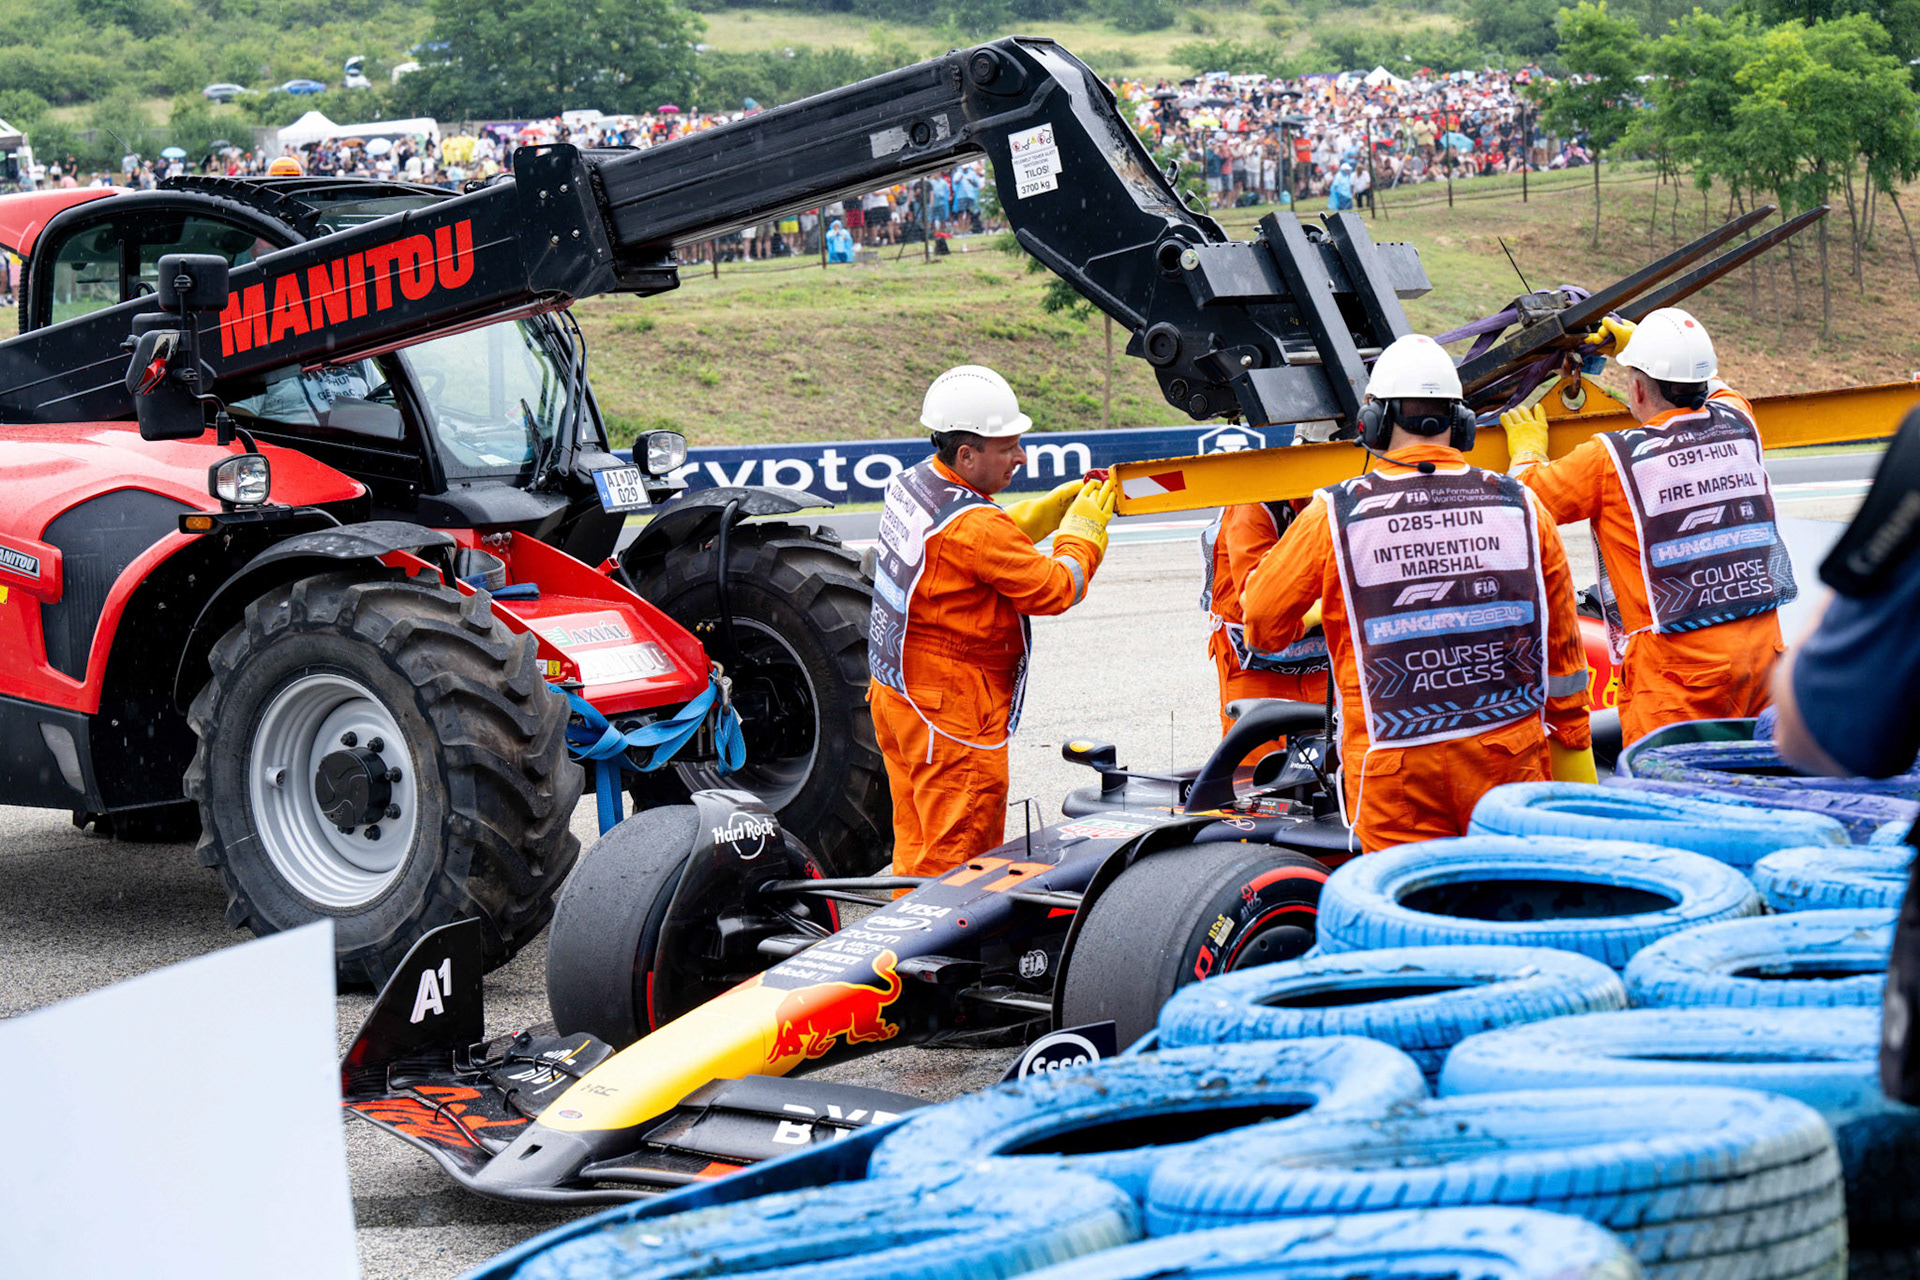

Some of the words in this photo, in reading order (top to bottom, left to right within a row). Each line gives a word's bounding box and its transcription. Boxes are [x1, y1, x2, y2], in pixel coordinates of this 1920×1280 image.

[1025, 165, 1049, 178] TILOS!
[1021, 182, 1039, 194] 3700
[1040, 180, 1051, 190] kg
[219, 218, 475, 357] MANITOU
[1667, 443, 1739, 468] 0391-HUN
[606, 471, 621, 488] AI
[624, 469, 639, 485] DP
[1659, 483, 1694, 504] FIRE
[1697, 472, 1758, 496] MARSHAL
[1446, 487, 1479, 495] Formula
[1388, 510, 1484, 534] 0285-HUN
[1374, 536, 1500, 563] INTERVENTION
[1401, 555, 1484, 577] MARSHAL
[1691, 559, 1766, 587] COURSE
[1698, 577, 1773, 607] ACCESS
[571, 622, 631, 645] AXIÁL
[1405, 641, 1504, 671] COURSE
[1412, 661, 1506, 693] ACCESS
[1278, 802, 1289, 813] 11
[711, 821, 744, 845] Hard
[744, 817, 776, 841] Rock
[940, 856, 1056, 893] 11
[896, 901, 952, 919] VISA
[840, 929, 902, 944] zoom
[770, 966, 817, 979] Mobil
[409, 957, 452, 1024] A1
